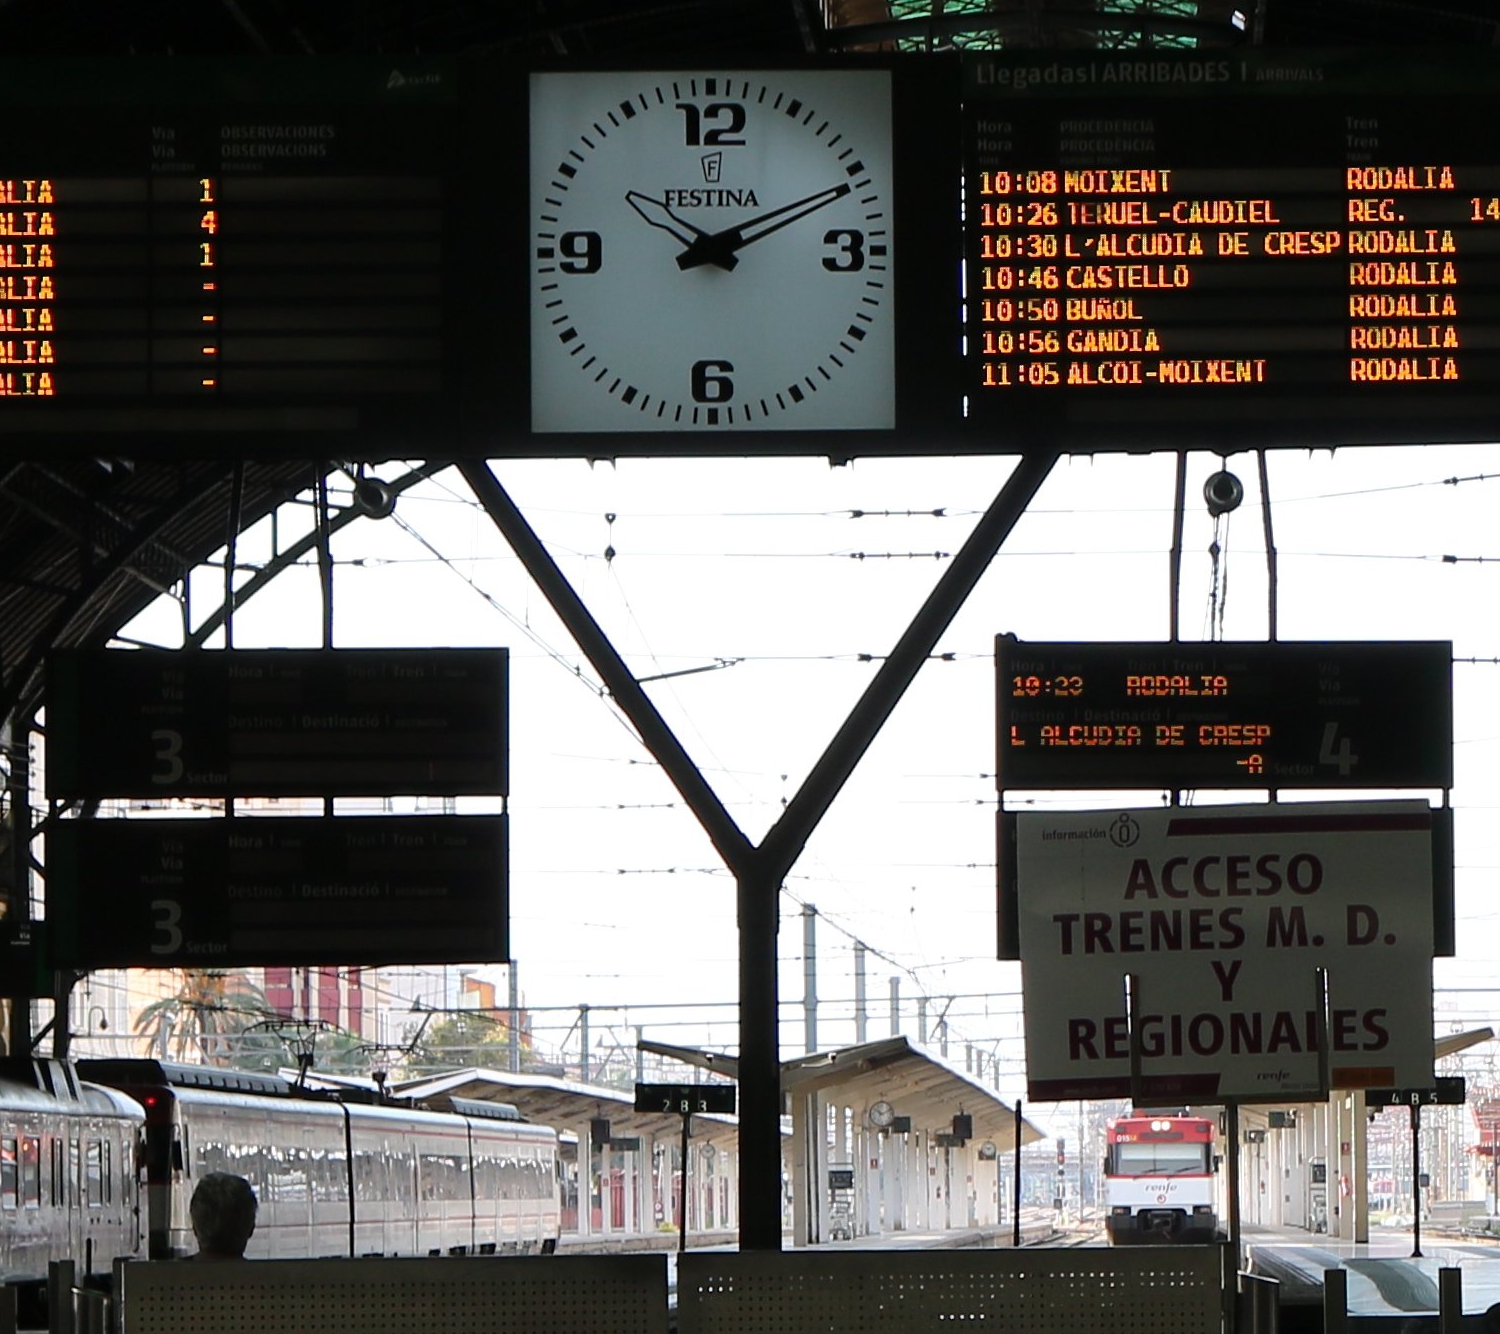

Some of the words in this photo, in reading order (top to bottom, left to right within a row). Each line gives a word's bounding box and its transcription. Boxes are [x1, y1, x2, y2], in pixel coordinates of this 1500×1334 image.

[977, 62, 1087, 89] Llegadas
[1103, 62, 1229, 83] ARRIBADES
[1256, 68, 1324, 82] ARRIVALS
[220, 125, 335, 139] OBSERVACIONES
[675, 103, 746, 146] 12
[220, 143, 327, 157] OBSERVACIONS
[199, 178, 214, 203] 1
[979, 170, 1061, 196] 10:08
[1064, 169, 1172, 195] MOIXENT
[1346, 165, 1455, 191] RODALIA
[664, 189, 760, 207] FESTINA
[980, 202, 1061, 228] 10:26
[1067, 199, 1281, 227] TERUEL-CAUDIEL
[1347, 198, 1405, 223] REG.
[200, 210, 219, 235] 4
[199, 242, 215, 267] 1
[559, 231, 602, 274] 9
[822, 229, 865, 272] 3
[980, 233, 1059, 259] 10:30
[1218, 231, 1250, 257] DE
[1264, 230, 1343, 256] CRESP
[1348, 229, 1457, 254] RODALIA
[981, 265, 1062, 290] 10:46
[1066, 264, 1191, 290] CASTELLO
[1349, 261, 1458, 287] RODALIA
[981, 297, 1062, 323] 10:50
[1065, 297, 1144, 322] BUÑOL
[1349, 293, 1458, 318] RODALIA
[982, 329, 1062, 355] 10:56
[1066, 328, 1161, 354] GANDIA
[1350, 324, 1461, 350] RODALIA
[691, 360, 734, 403] 6
[982, 361, 1061, 387] 11:05
[1066, 359, 1267, 386] ALCOI-MOIXENT
[1349, 356, 1459, 382] RODALIA
[1126, 675, 1228, 696] RODALIA
[1040, 725, 1141, 746] ALCUDIA
[1155, 725, 1185, 746] DE
[1198, 724, 1271, 746] CRESP
[1319, 722, 1359, 775] 4
[150, 729, 183, 784] 3
[1042, 826, 1107, 841] información
[1123, 853, 1323, 900] ACCESO
[150, 899, 183, 954] 3
[1053, 908, 1245, 955] TRENES
[1266, 905, 1324, 948] M.
[1347, 904, 1397, 946] D.
[1211, 960, 1242, 1002] Y
[1068, 1009, 1390, 1060] REGIONALES
[1256, 1070, 1290, 1082] renfe
[1392, 1092, 1400, 1105] 4
[1411, 1092, 1420, 1105] B
[1430, 1092, 1438, 1105] 5
